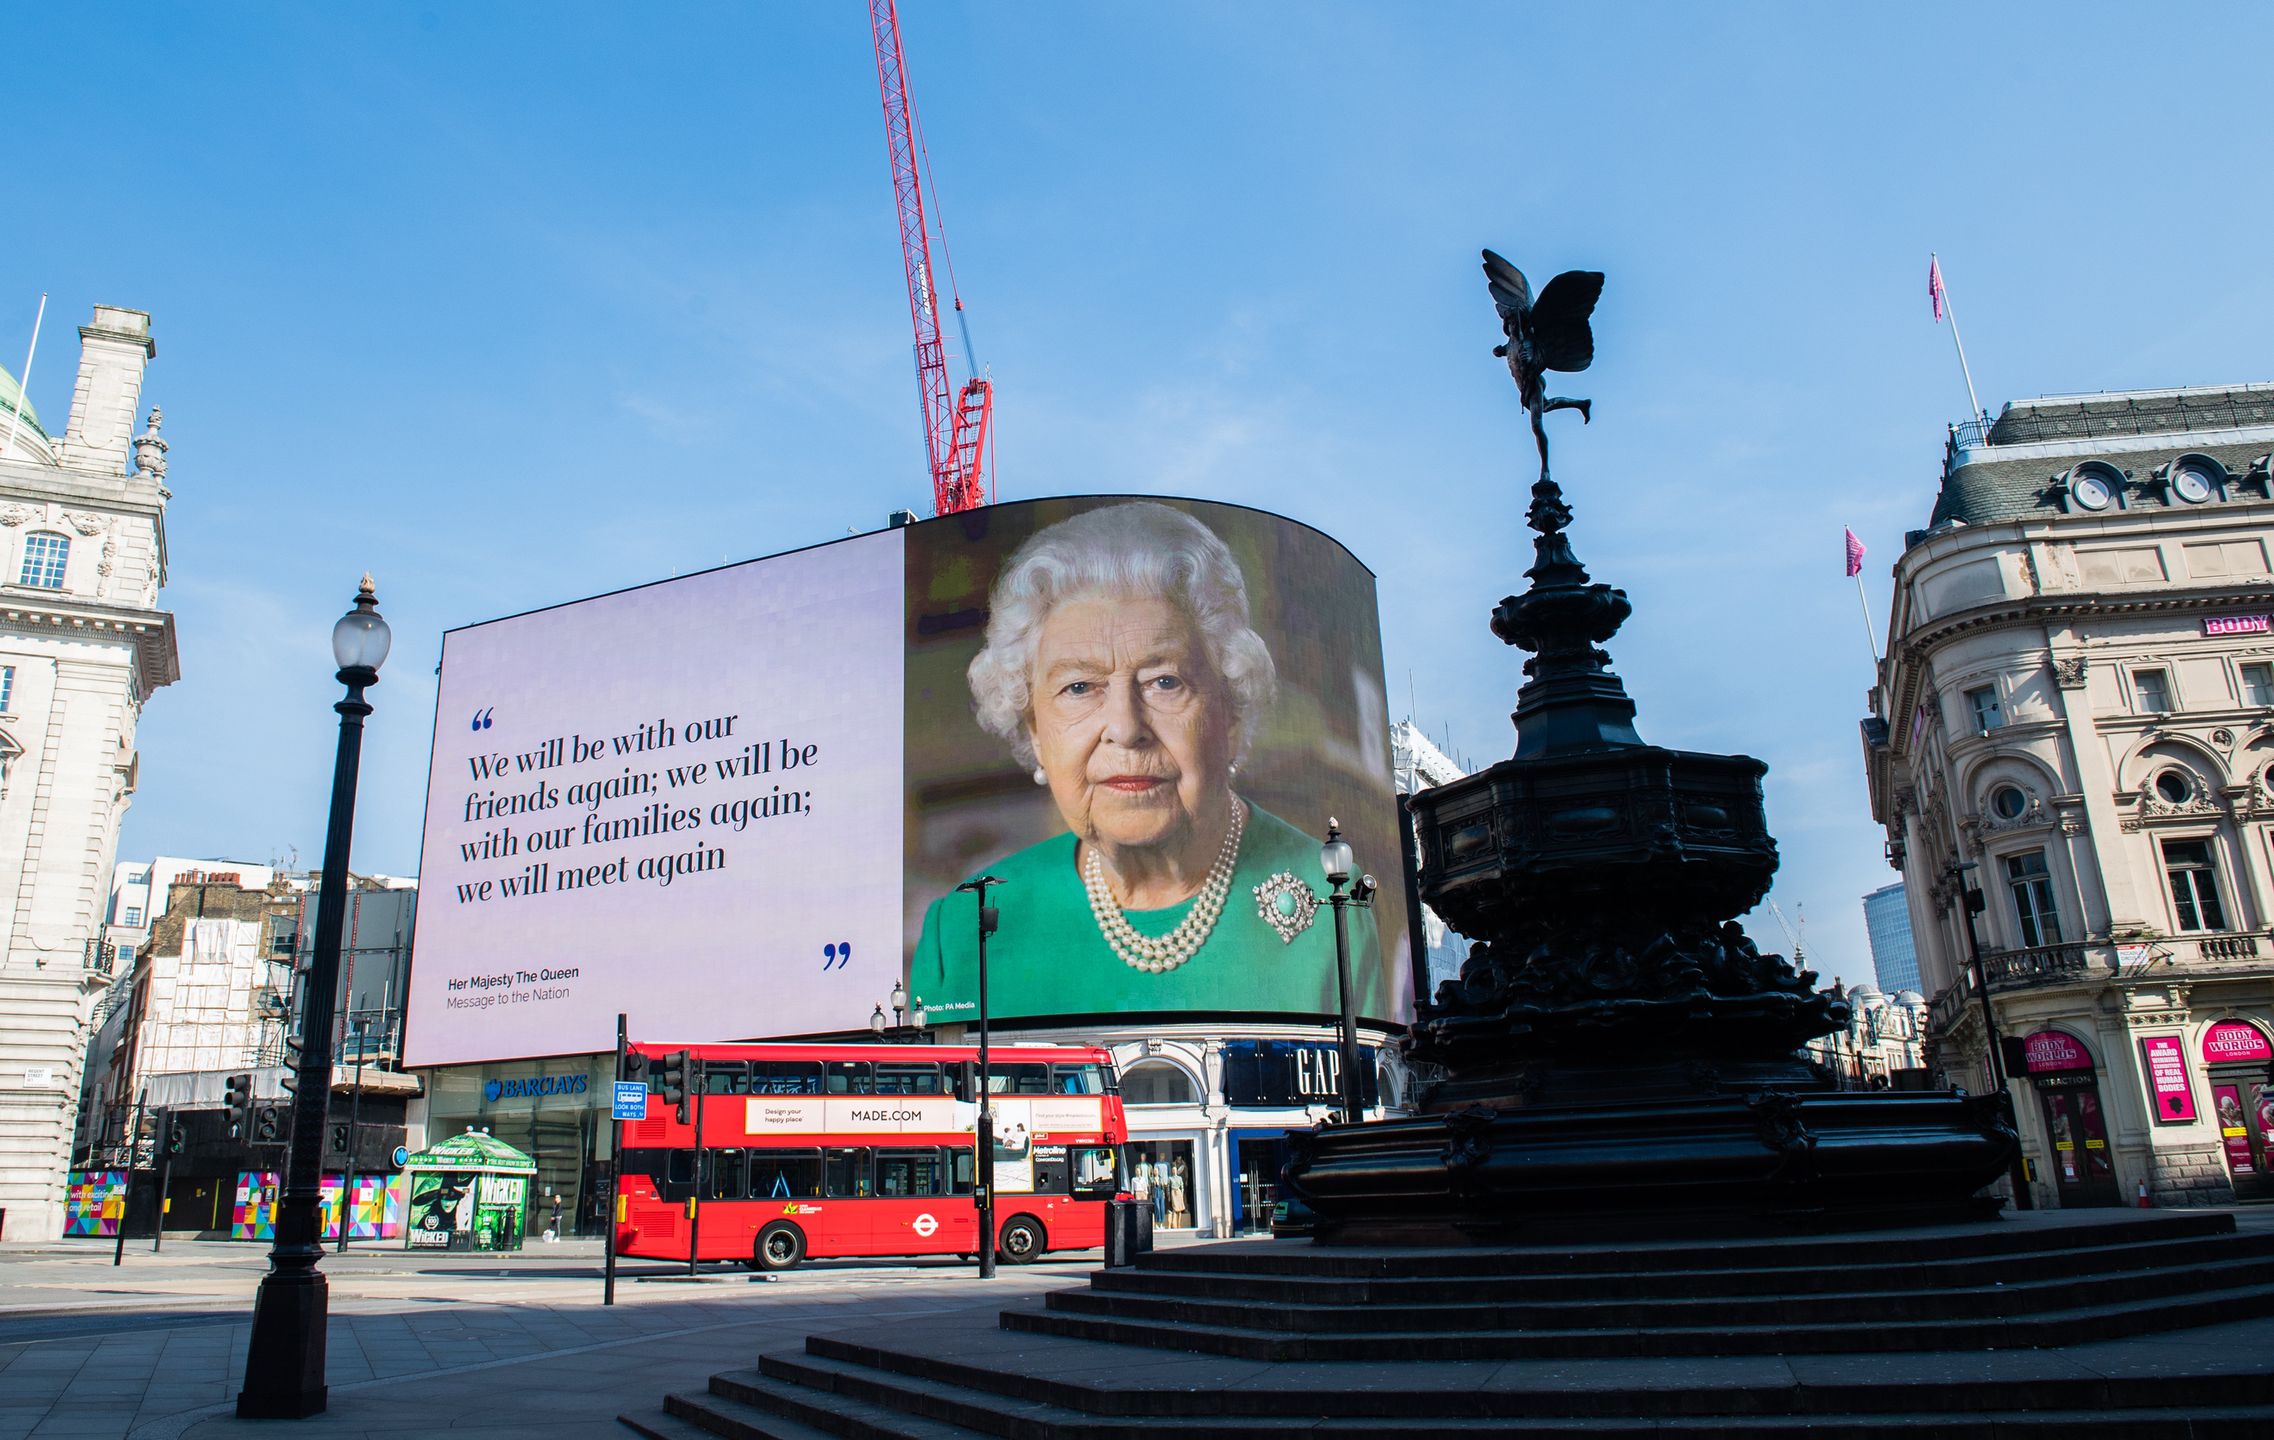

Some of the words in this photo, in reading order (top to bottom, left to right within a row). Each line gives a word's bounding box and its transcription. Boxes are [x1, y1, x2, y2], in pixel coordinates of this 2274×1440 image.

[2204, 615, 2269, 634] BODY
[468, 753, 509, 781] We
[516, 737, 564, 773] will
[572, 735, 605, 763] be
[612, 718, 676, 756] with
[685, 715, 738, 743] our
[463, 781, 559, 822] friends
[567, 767, 658, 811] again;
[666, 762, 707, 788] we
[715, 742, 771, 780] will
[780, 739, 818, 771] be
[460, 827, 518, 863] with
[526, 826, 576, 853] our
[582, 802, 702, 846] families
[710, 785, 811, 832] again;
[456, 880, 492, 904] we
[500, 862, 549, 898] will
[556, 856, 630, 891] meet
[637, 841, 726, 887] again
[448, 978, 468, 991] Her
[470, 973, 514, 990] Majesty
[516, 971, 537, 984] The
[540, 967, 579, 981] Queen
[447, 995, 495, 1010] Message
[498, 992, 509, 1005] to
[511, 989, 530, 1004] the
[533, 986, 570, 1001] Nation
[923, 1004, 944, 1012] Photo:
[945, 1002, 954, 1010] PA
[955, 1001, 976, 1010] Media
[2216, 1030, 2252, 1041] BODY
[2031, 1040, 2066, 1052] BODY
[2208, 1039, 2265, 1052] WORLDS
[2025, 1049, 2077, 1063] WORLDS
[2151, 1048, 2177, 1057] AWARD
[1297, 1048, 1340, 1095] GAP
[2164, 1068, 2182, 1076] REAL
[503, 1074, 588, 1098] BARCLAYS
[2038, 1075, 2091, 1087] ATTRACTION
[2156, 1076, 2184, 1084] HUMAN
[2158, 1083, 2186, 1092] BODIES
[765, 1108, 786, 1116] Design
[851, 1110, 922, 1121] MADE.COM
[1033, 1146, 1067, 1154] Metroline
[71, 1189, 86, 1199] with
[69, 1203, 81, 1211] and
[83, 1202, 102, 1211] retail
